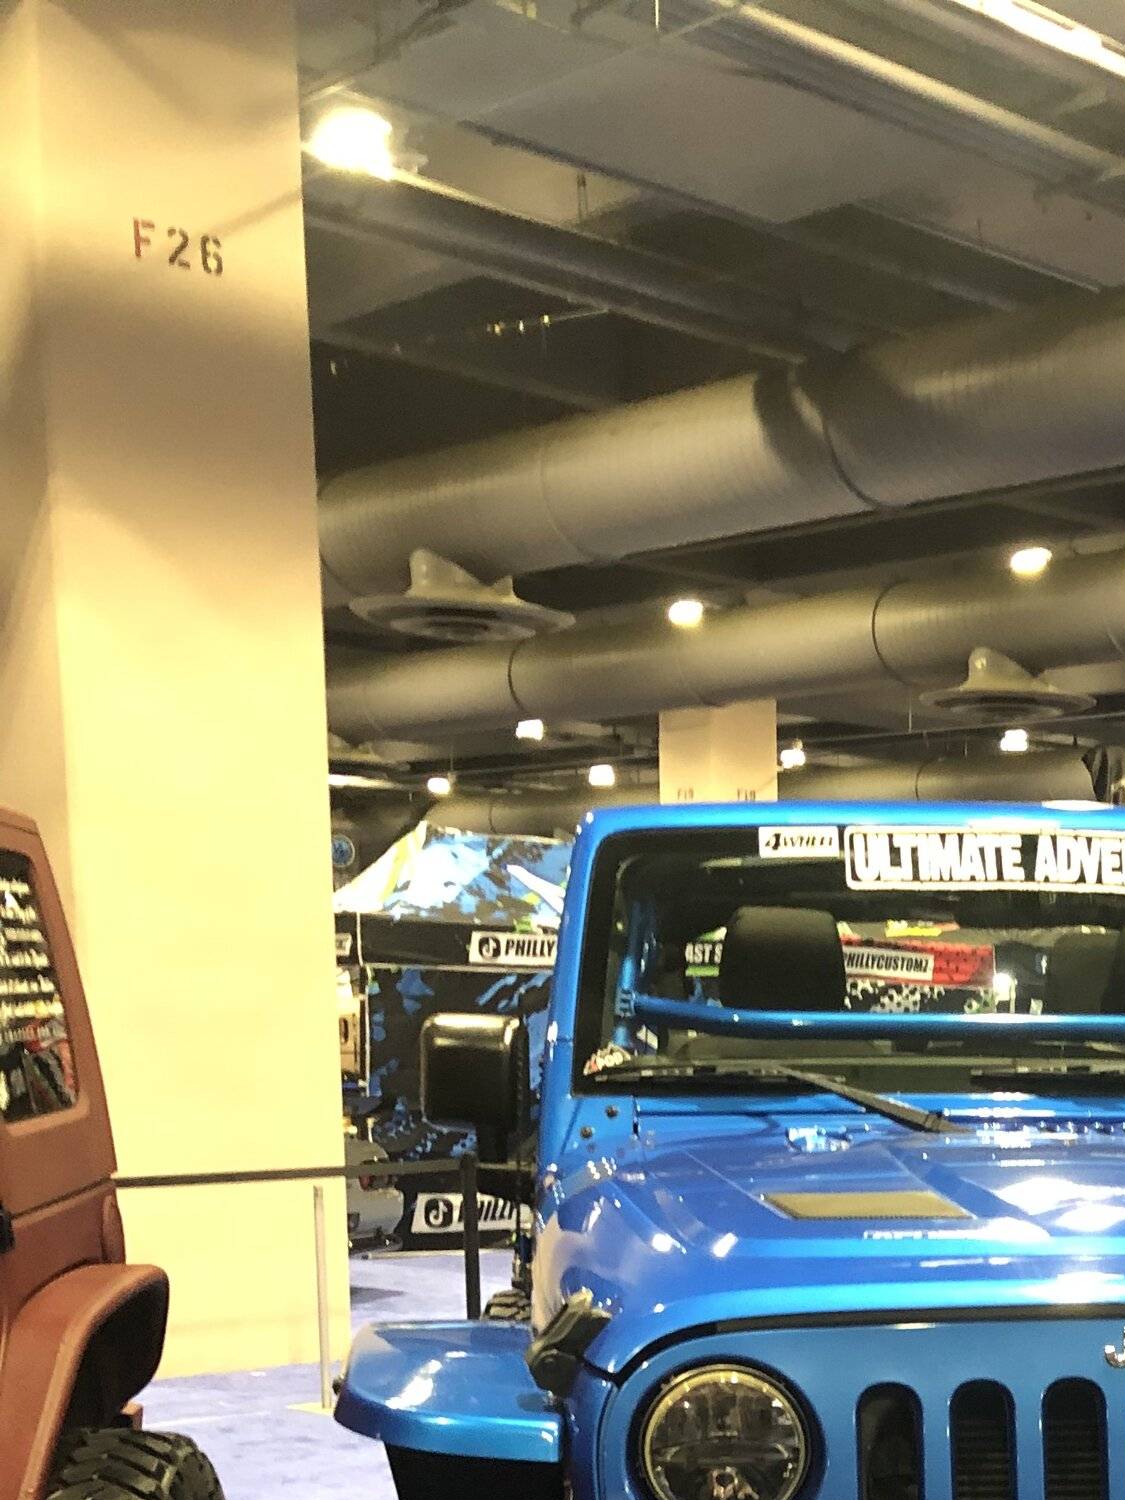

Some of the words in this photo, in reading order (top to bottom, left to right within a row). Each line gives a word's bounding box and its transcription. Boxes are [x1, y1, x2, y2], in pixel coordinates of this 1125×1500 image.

[133, 216, 223, 276] F26
[851, 832, 1025, 881] ULTIMATE
[505, 938, 556, 957] PHILLY
